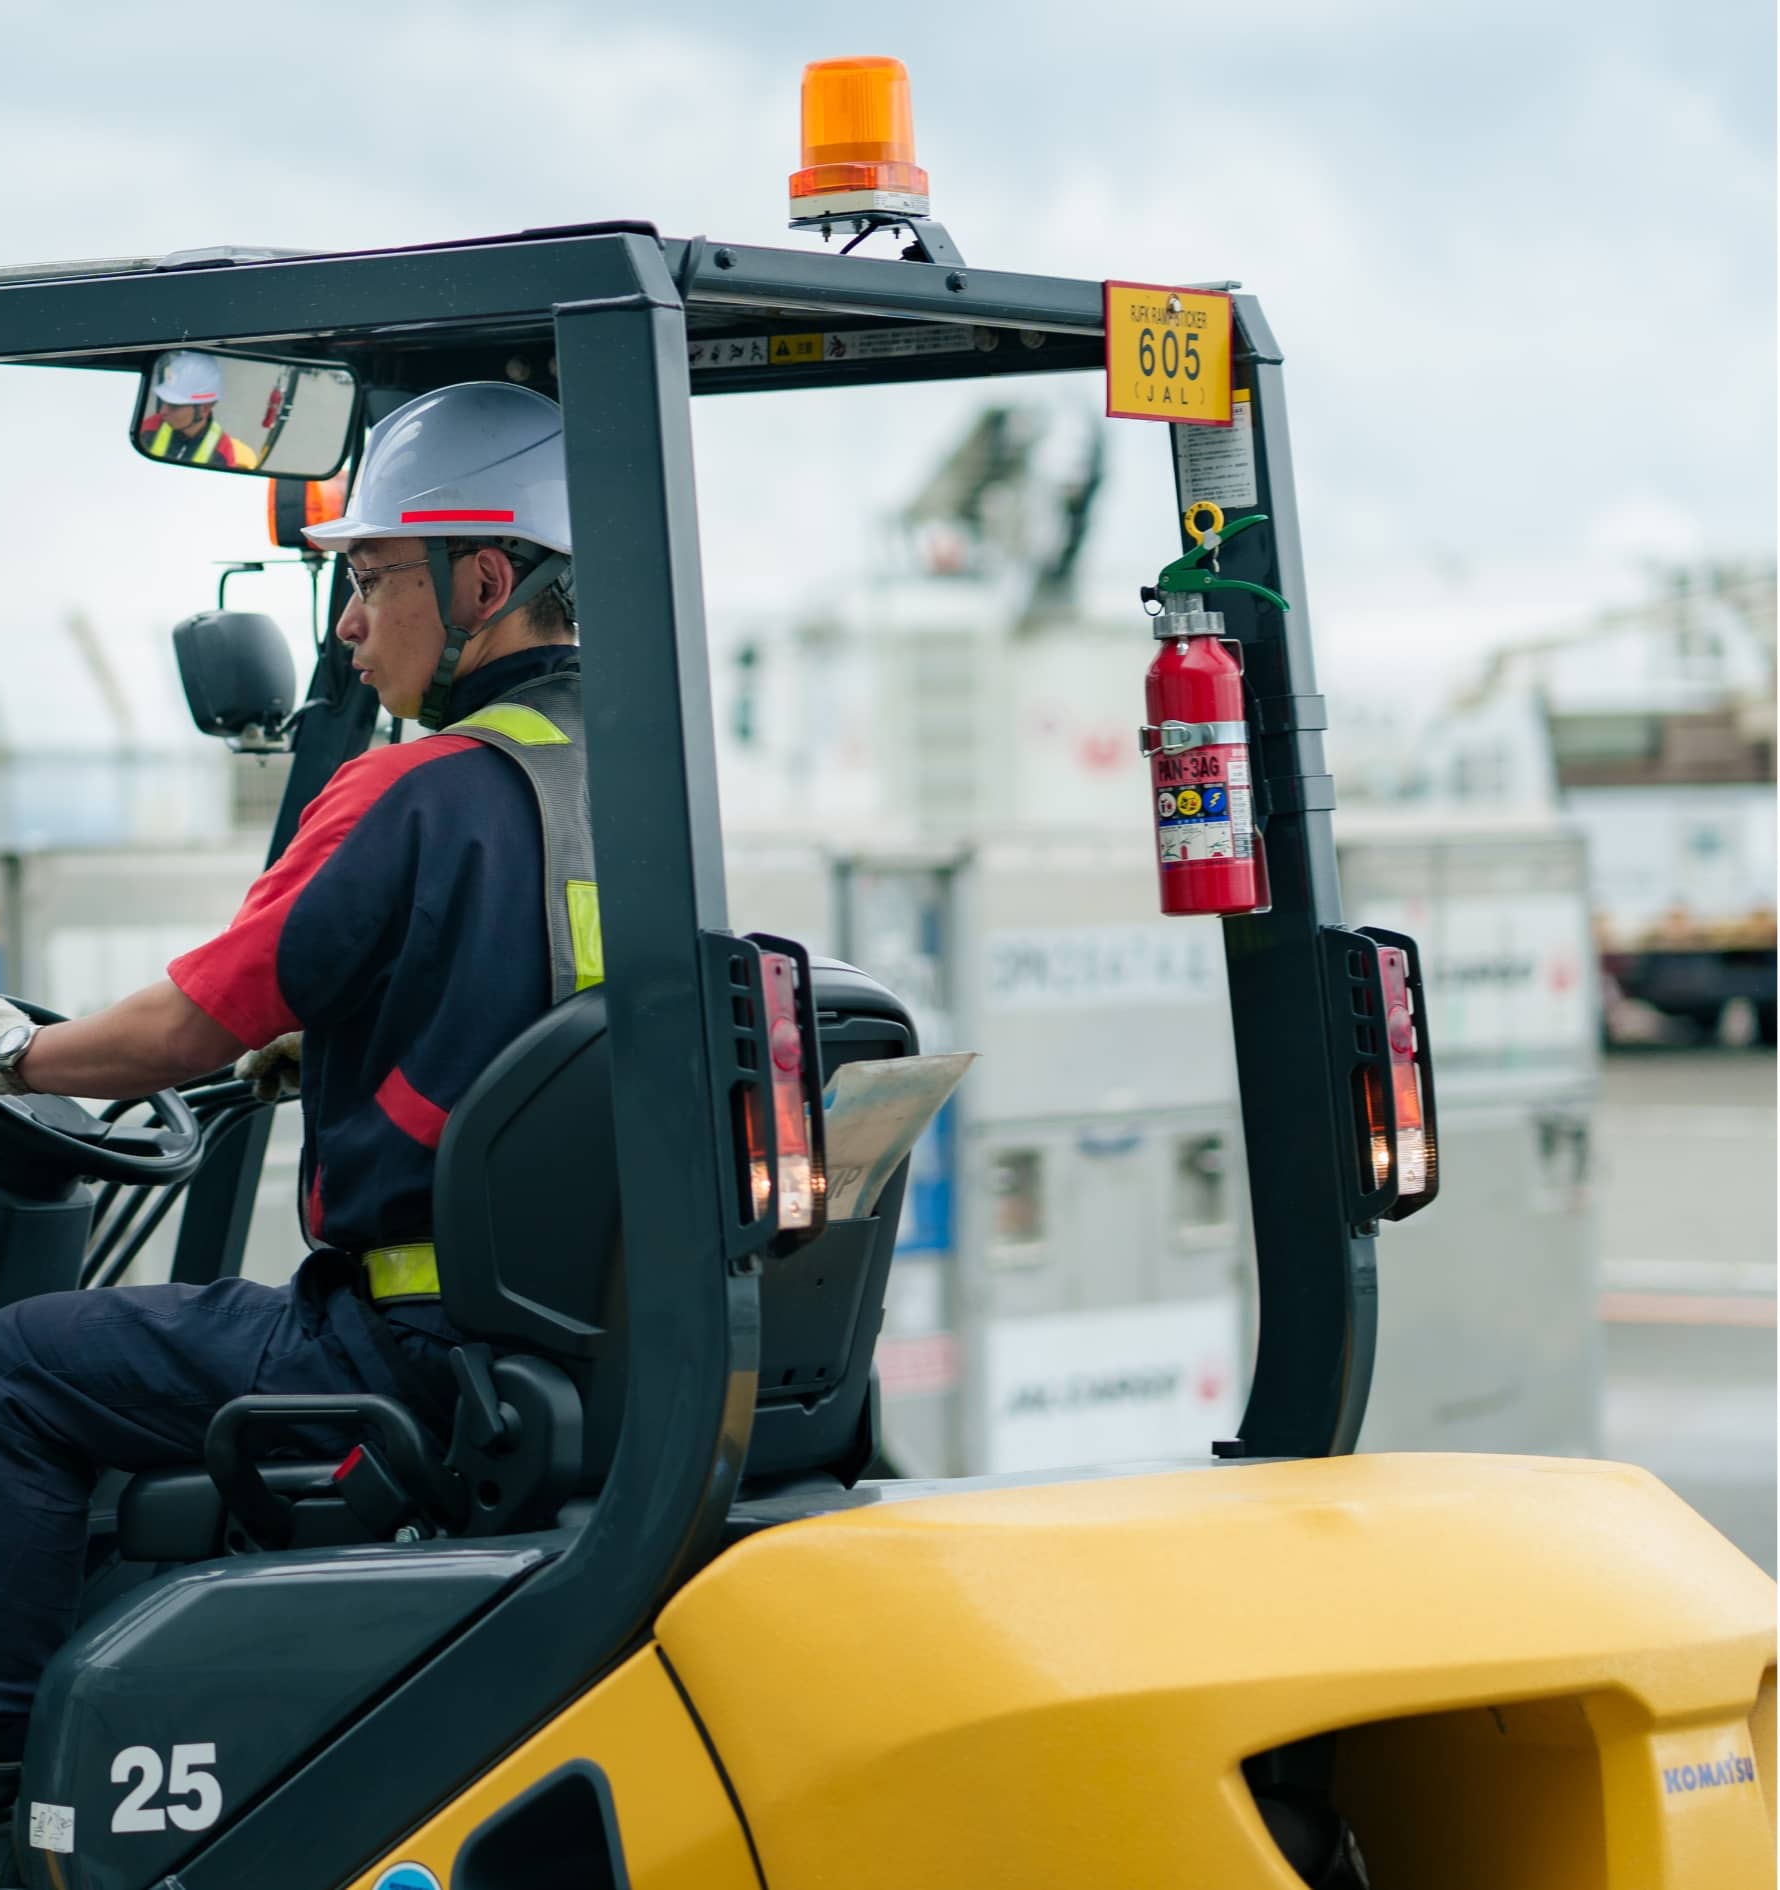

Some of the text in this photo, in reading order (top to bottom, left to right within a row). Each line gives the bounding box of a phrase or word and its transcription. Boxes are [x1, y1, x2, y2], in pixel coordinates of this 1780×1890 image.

[1139, 328, 1201, 381] 605
[1157, 756, 1220, 781] PAN-3AG
[110, 1742, 223, 1833] 25
[1663, 1752, 1755, 1794] KOMATSU
